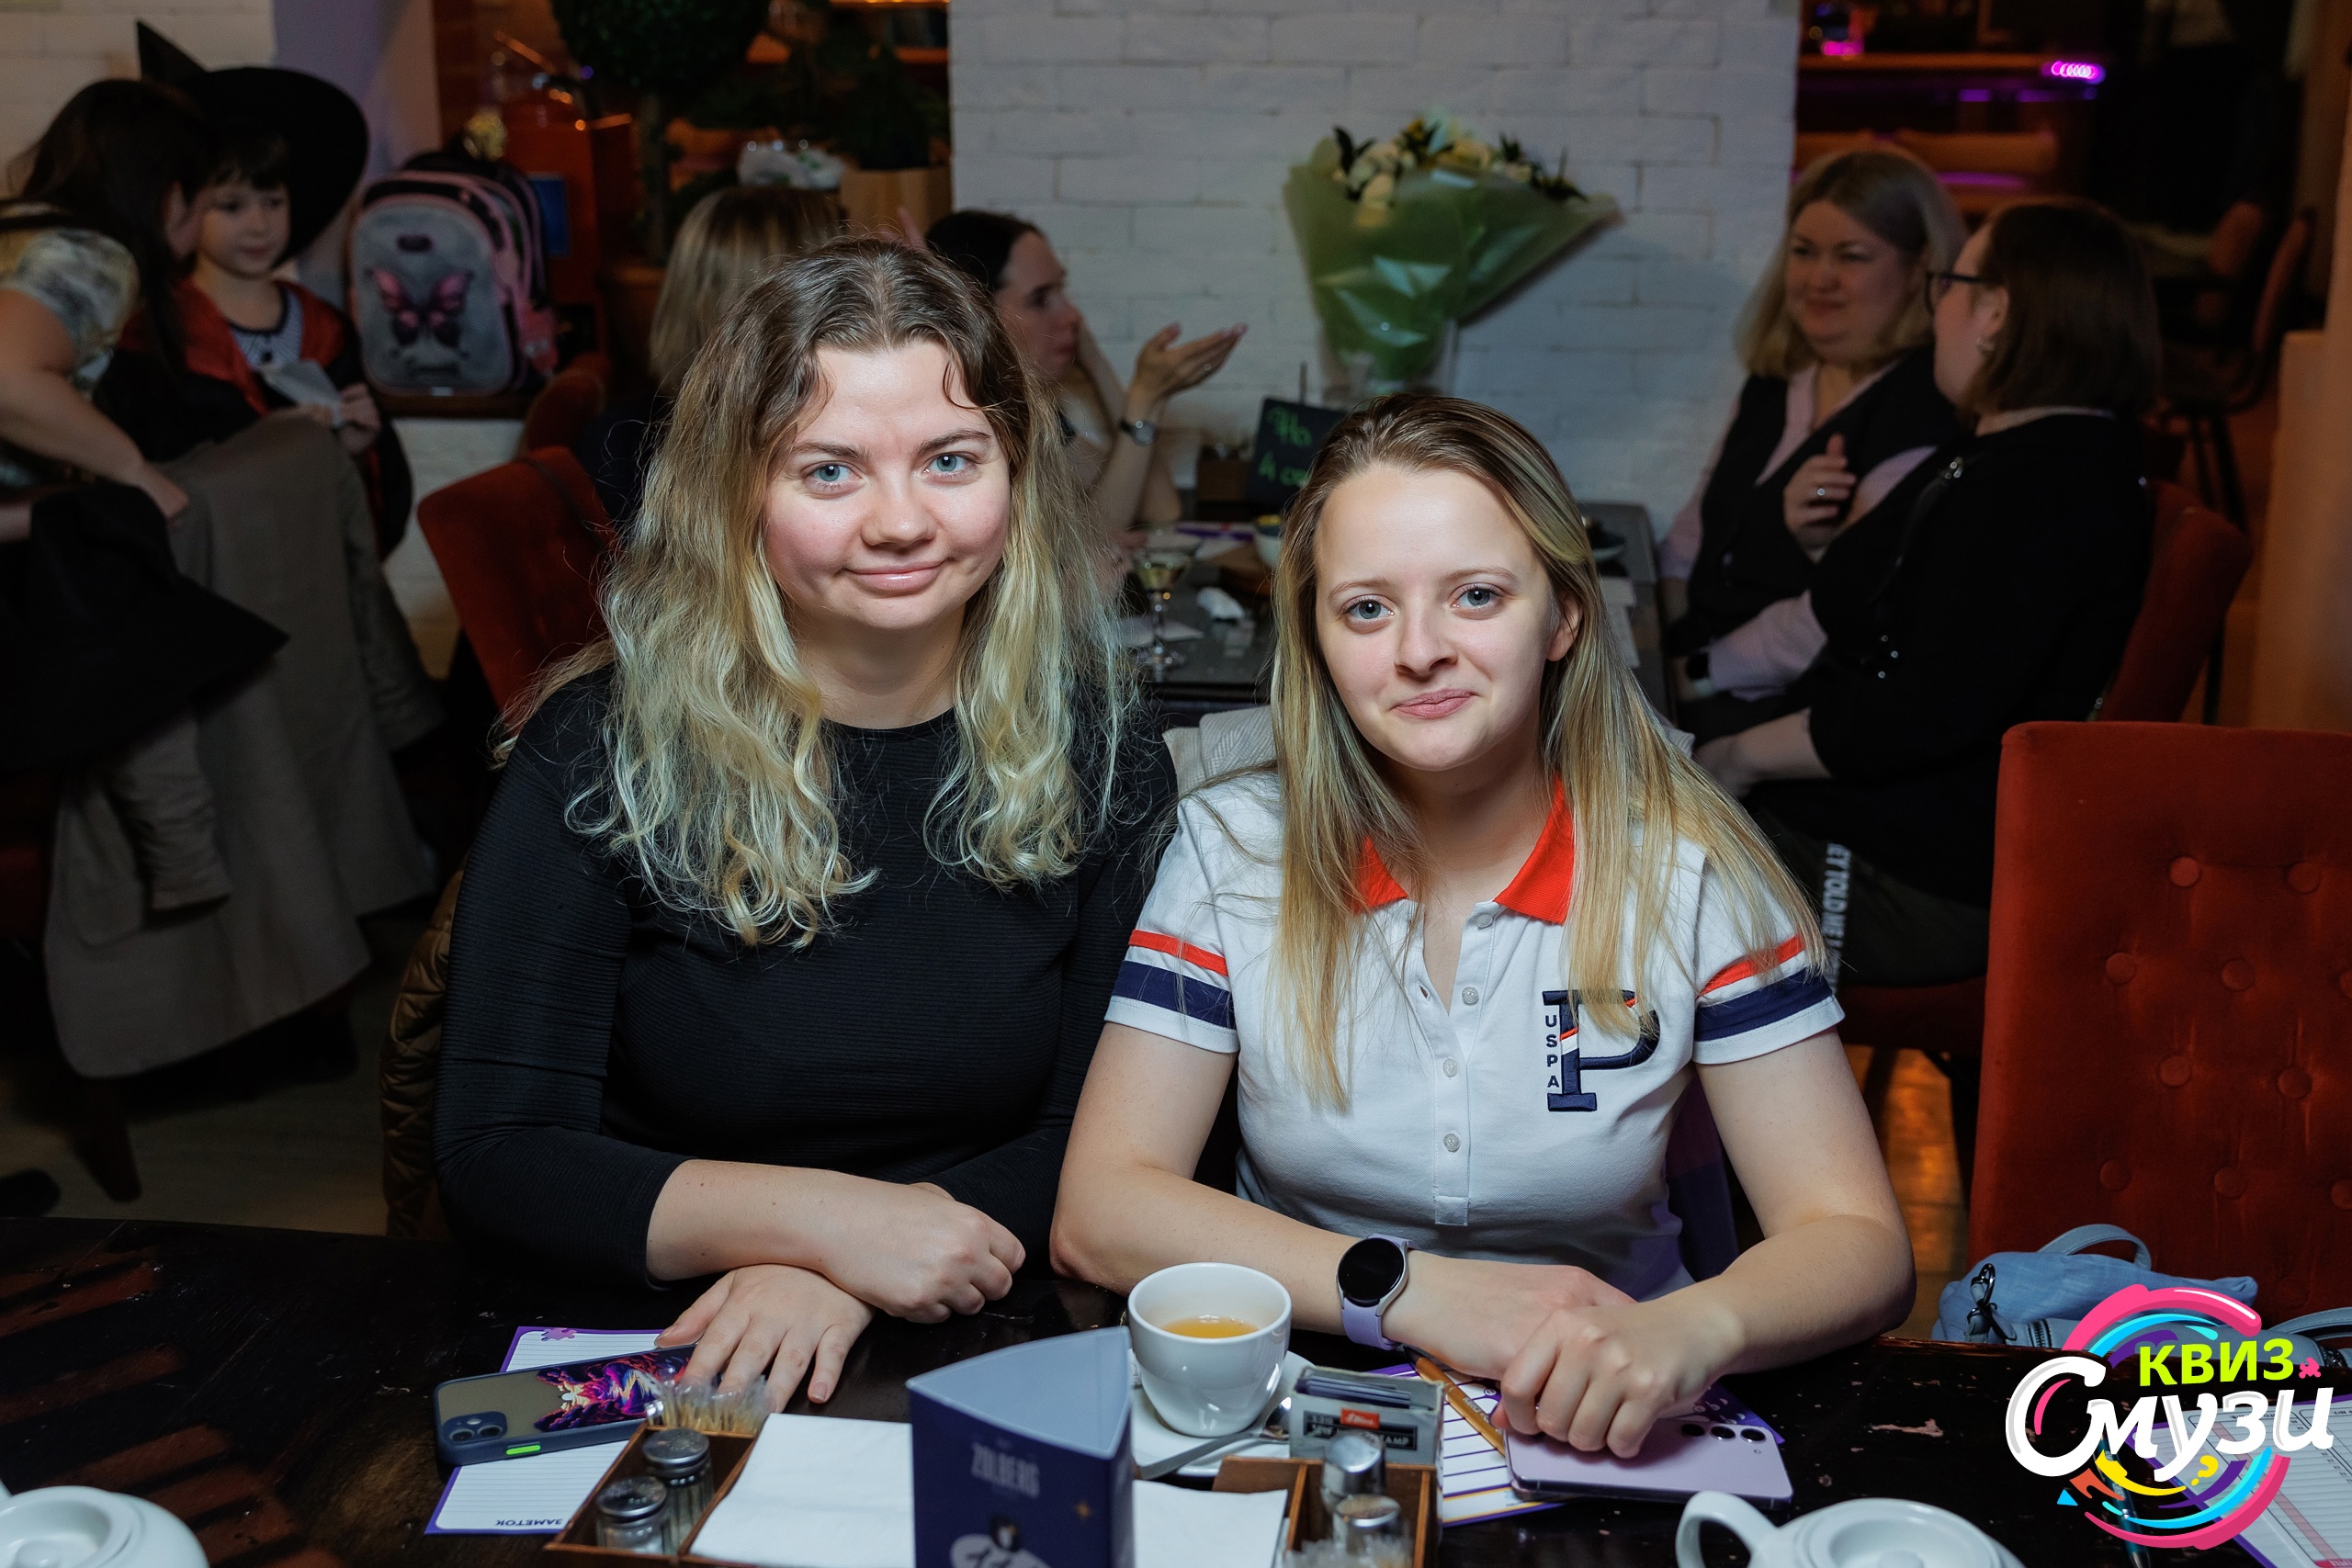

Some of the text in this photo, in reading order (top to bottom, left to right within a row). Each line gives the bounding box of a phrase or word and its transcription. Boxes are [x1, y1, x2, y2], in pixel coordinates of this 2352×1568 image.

[1822, 870, 1849, 913] TOLD
[1545, 1014, 1560, 1088] USPA
[495, 1517, 563, 1527] ЗАМЕТОК
